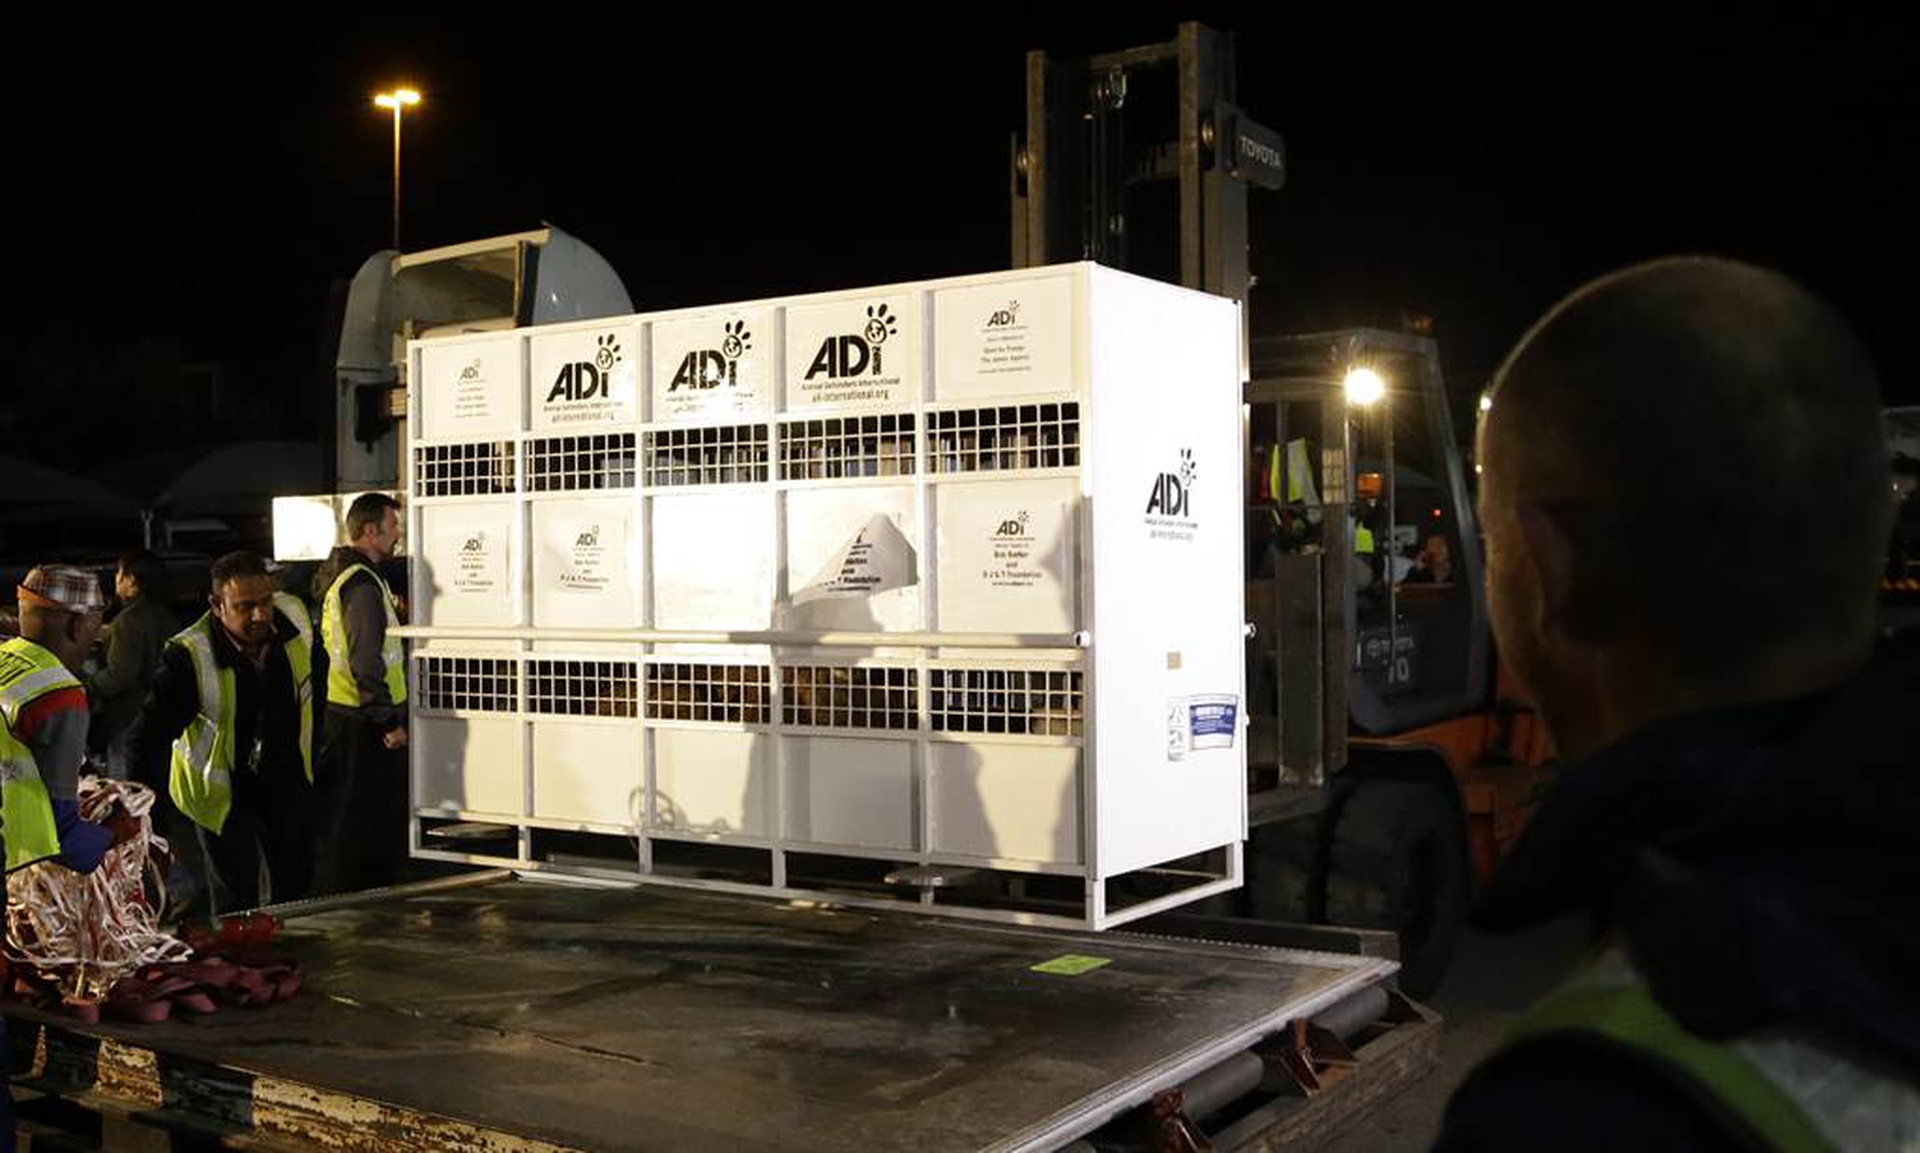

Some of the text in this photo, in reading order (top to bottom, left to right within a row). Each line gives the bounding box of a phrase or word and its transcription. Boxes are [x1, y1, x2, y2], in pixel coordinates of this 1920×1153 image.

[1240, 135, 1282, 169] TOYOTA
[987, 306, 1017, 327] ADi
[668, 335, 742, 392] ADi
[804, 319, 887, 380] ADi
[546, 347, 614, 403] ADi
[1146, 462, 1191, 517] ADi
[576, 529, 598, 546] ADi
[996, 517, 1026, 535] ADi
